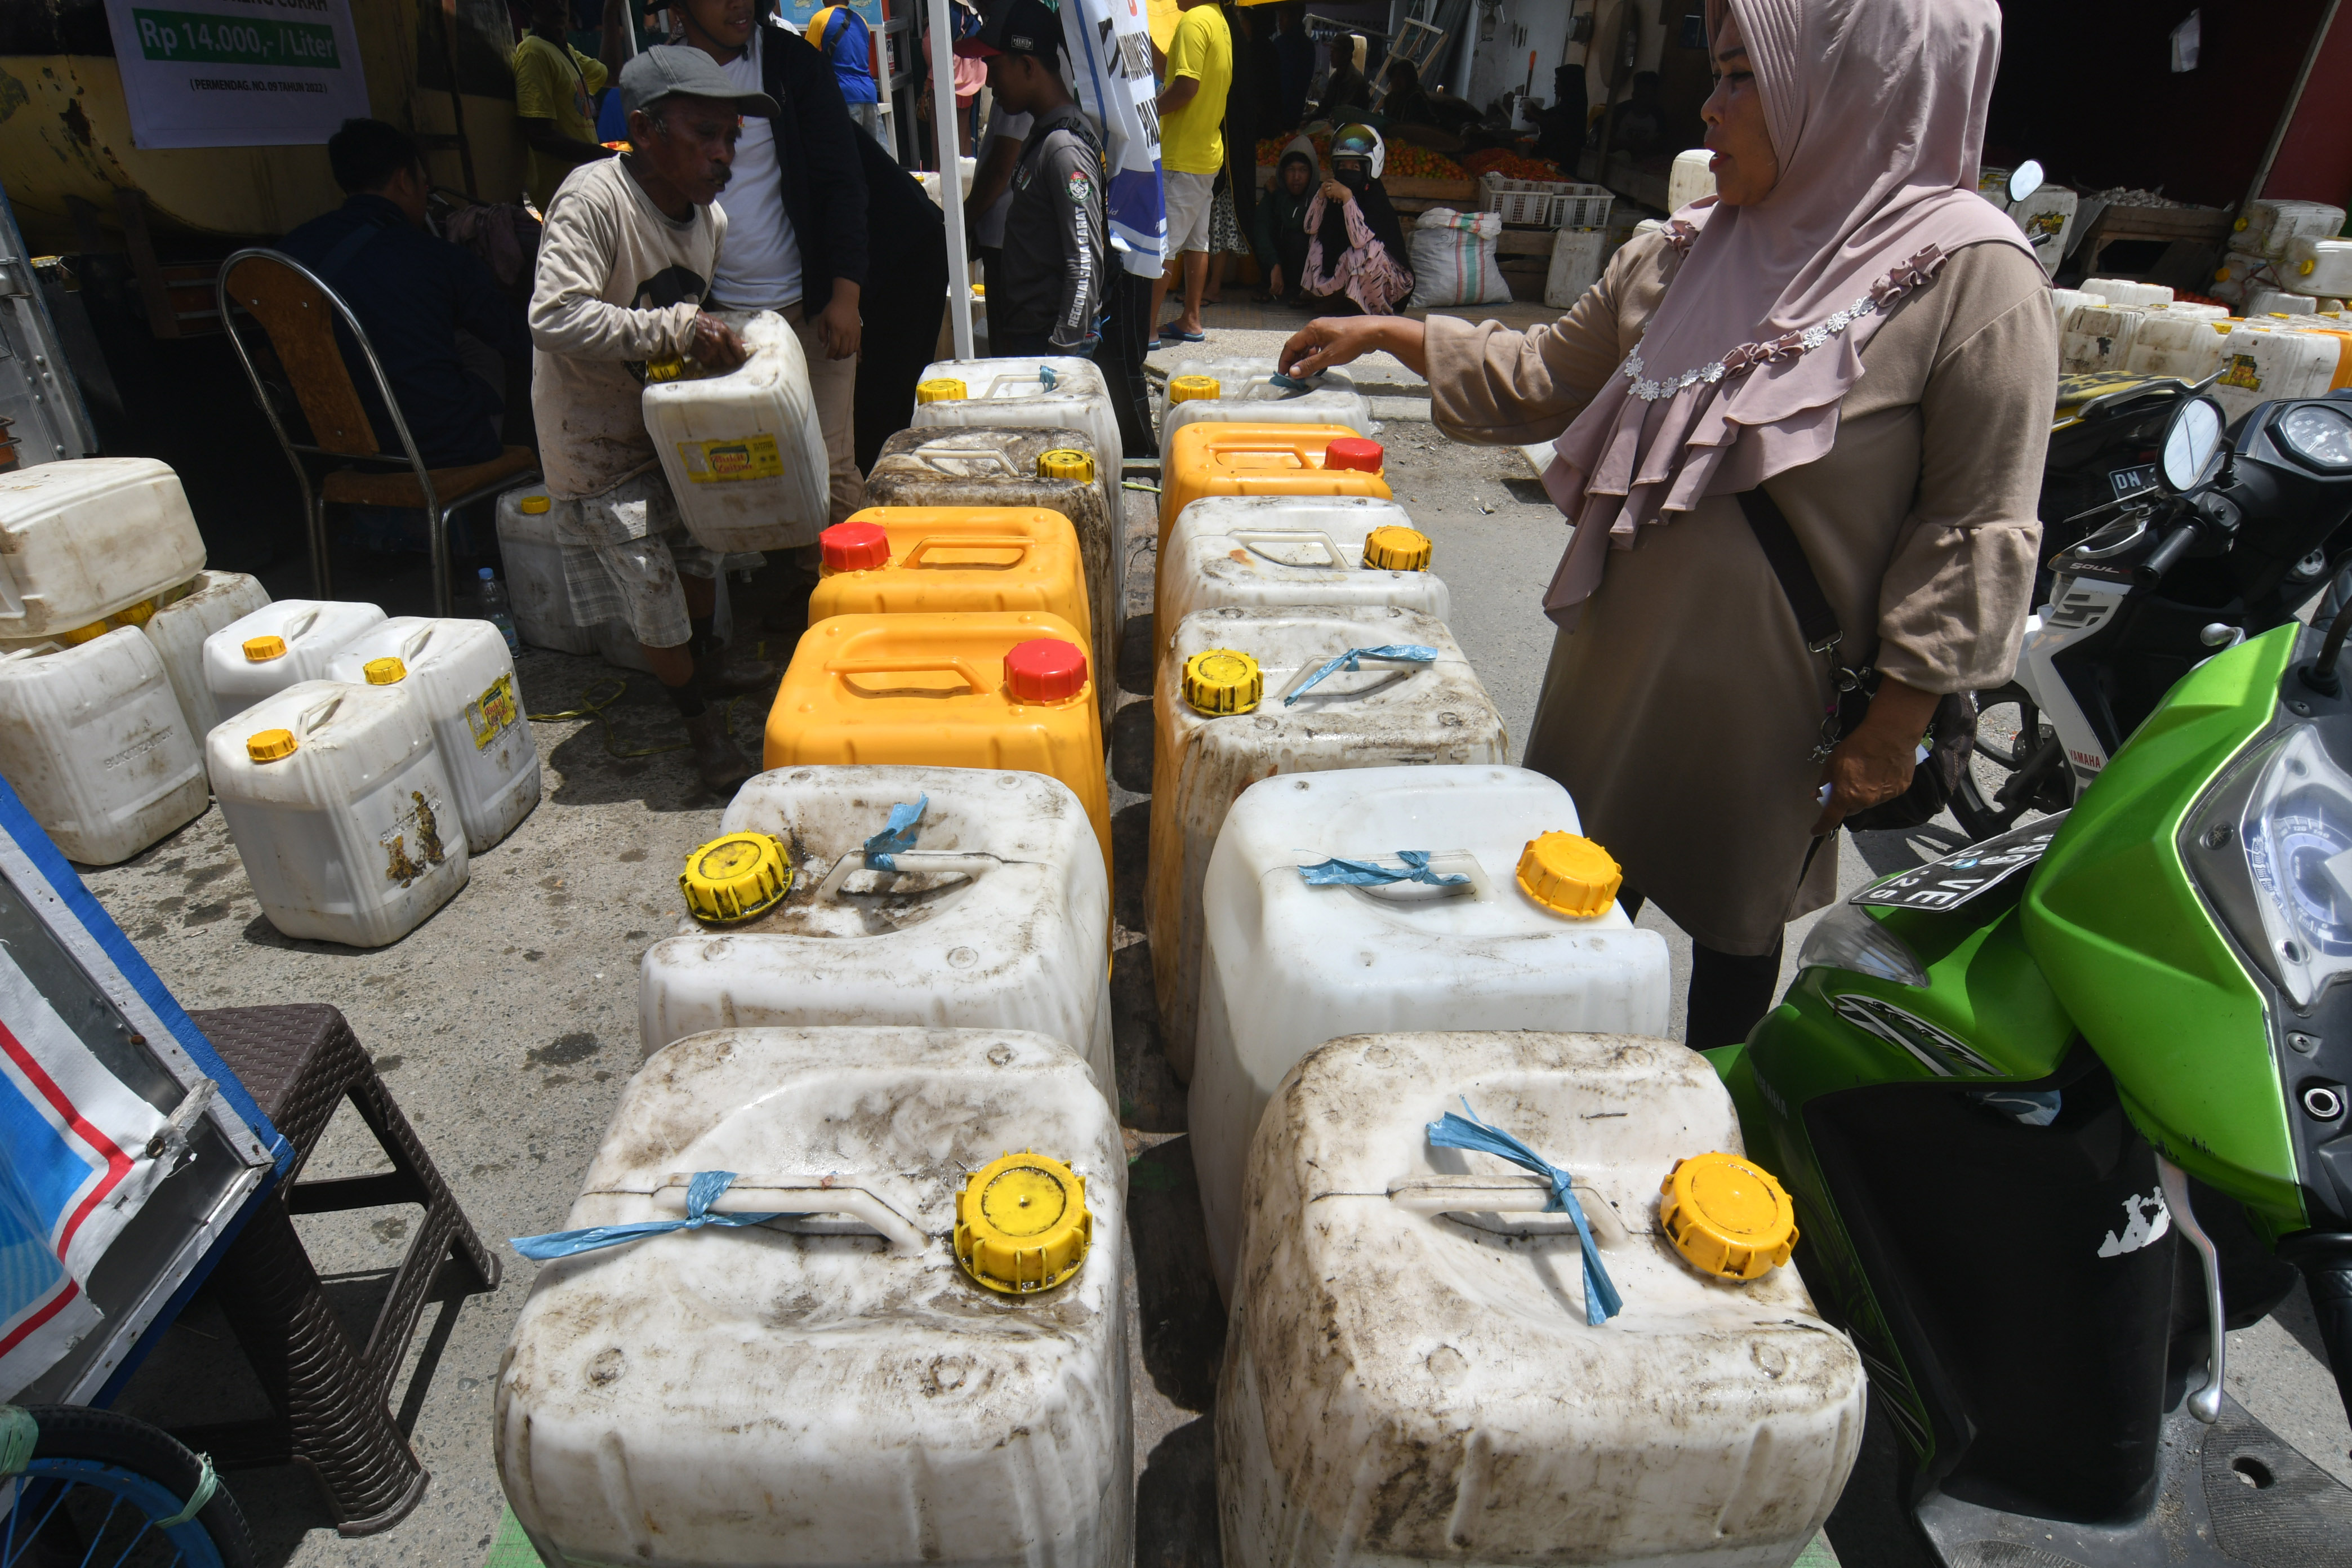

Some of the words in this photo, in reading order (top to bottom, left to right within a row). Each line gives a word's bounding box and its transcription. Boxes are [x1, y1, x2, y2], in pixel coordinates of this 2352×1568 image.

[139, 18, 178, 56] Rp
[288, 29, 333, 57] Liter
[278, 82, 305, 92] TAHUN
[306, 83, 324, 93] 2022
[1067, 278, 1089, 328] REGIONAL
[2114, 471, 2141, 489] DN
[2069, 562, 2120, 574] SOUL
[484, 698, 502, 716] Bukit
[2068, 748, 2101, 769] YAMAHA
